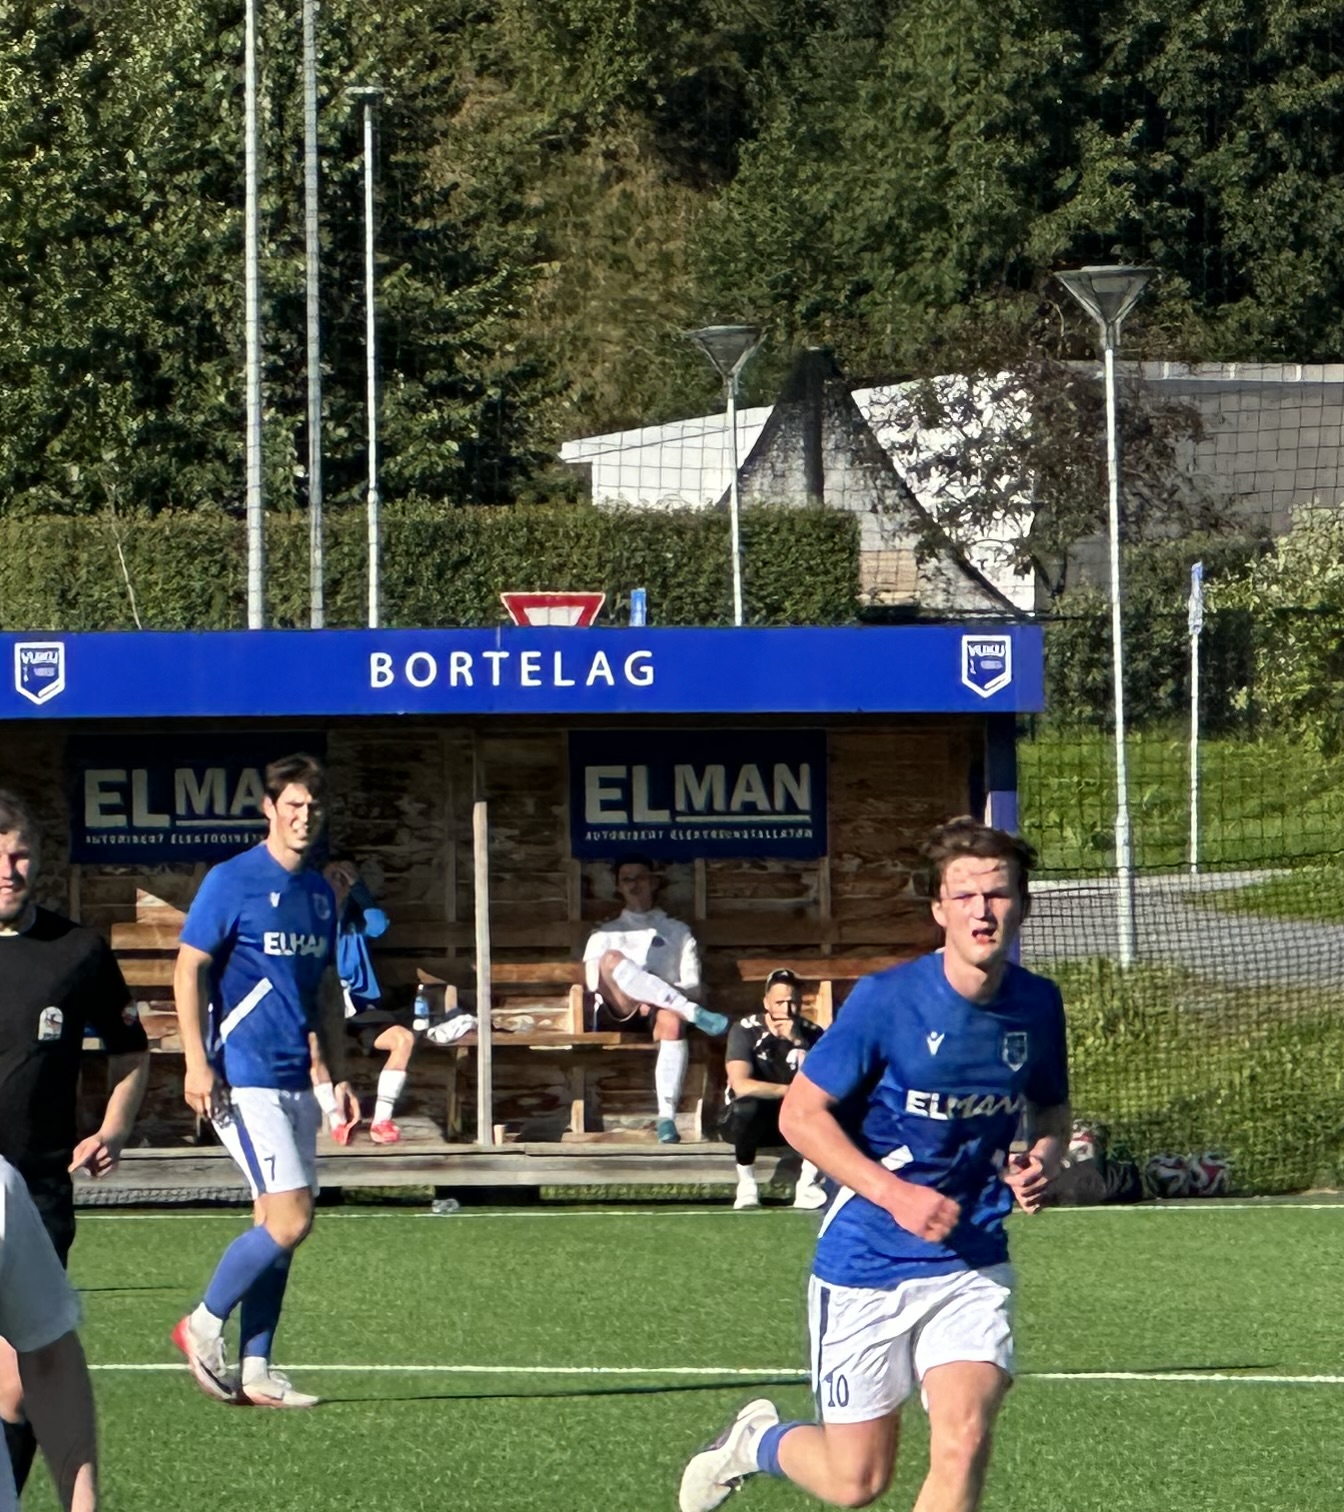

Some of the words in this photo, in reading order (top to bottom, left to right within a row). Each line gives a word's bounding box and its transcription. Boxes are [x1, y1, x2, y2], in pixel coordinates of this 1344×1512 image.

[369, 650, 654, 688] BORTELAG
[84, 768, 266, 829] ELMA
[263, 1155, 277, 1182] 7
[824, 1373, 850, 1407] 10
